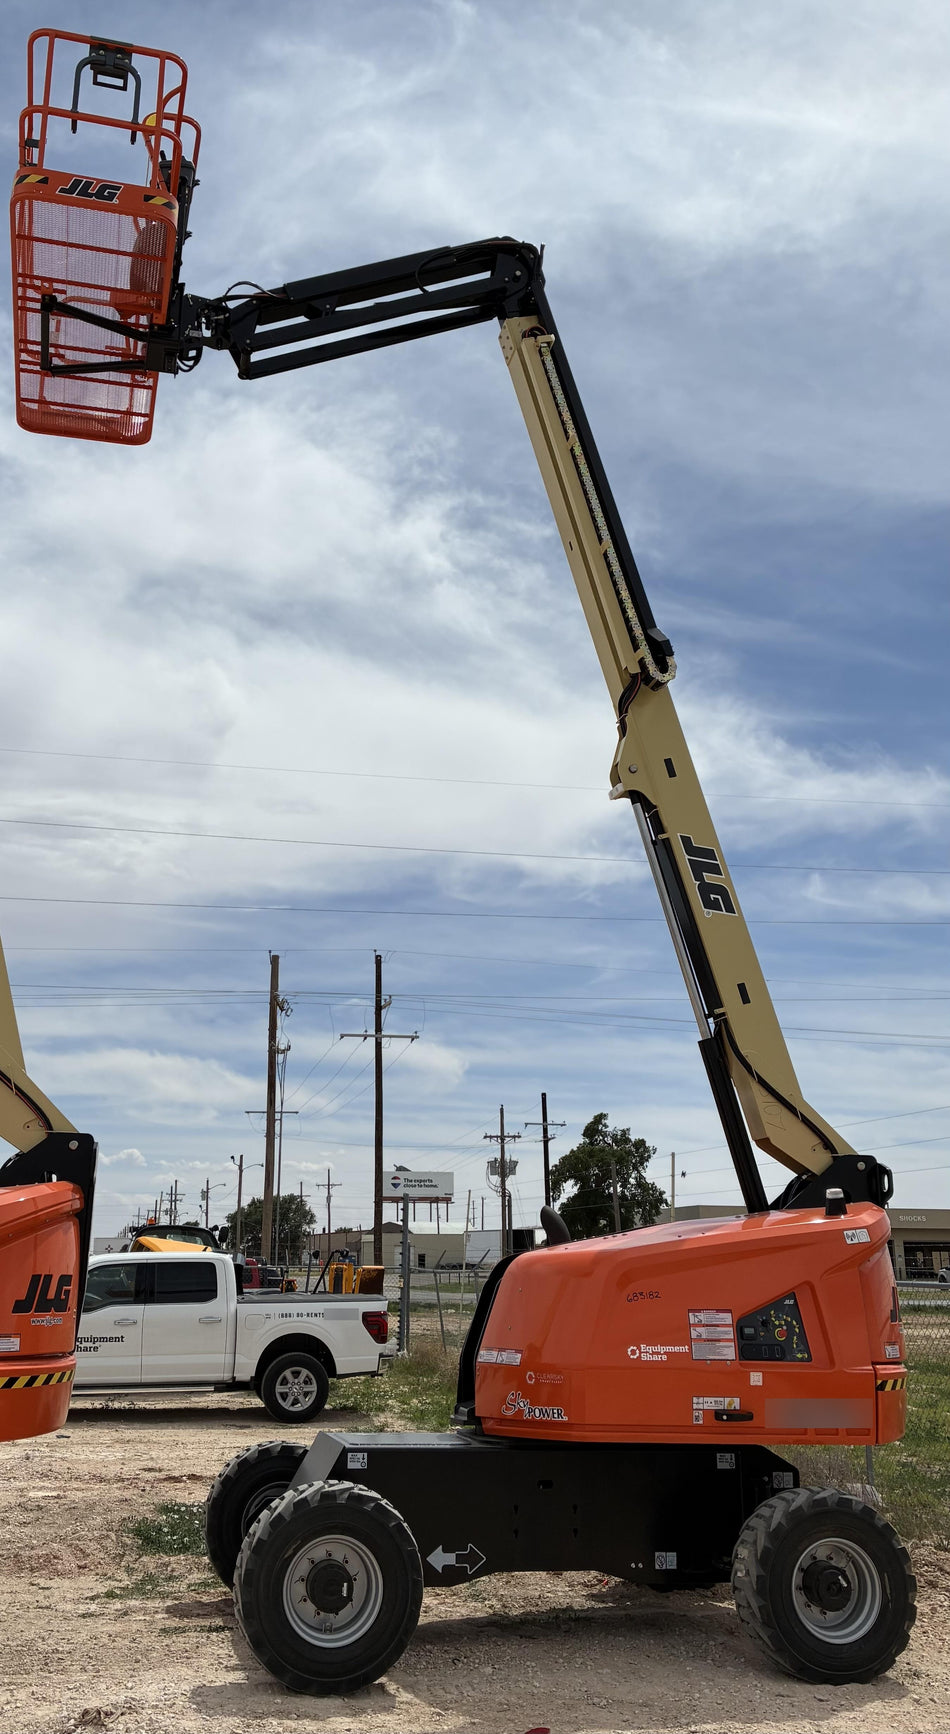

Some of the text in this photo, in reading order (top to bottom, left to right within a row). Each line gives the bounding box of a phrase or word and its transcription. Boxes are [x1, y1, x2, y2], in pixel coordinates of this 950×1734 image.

[56, 177, 123, 203] JLG
[677, 833, 738, 916] JLG
[12, 1274, 73, 1313] JLG
[76, 1334, 124, 1344] quipment
[76, 1344, 99, 1352] hare
[640, 1344, 689, 1354] Equipment
[640, 1353, 667, 1361] Share
